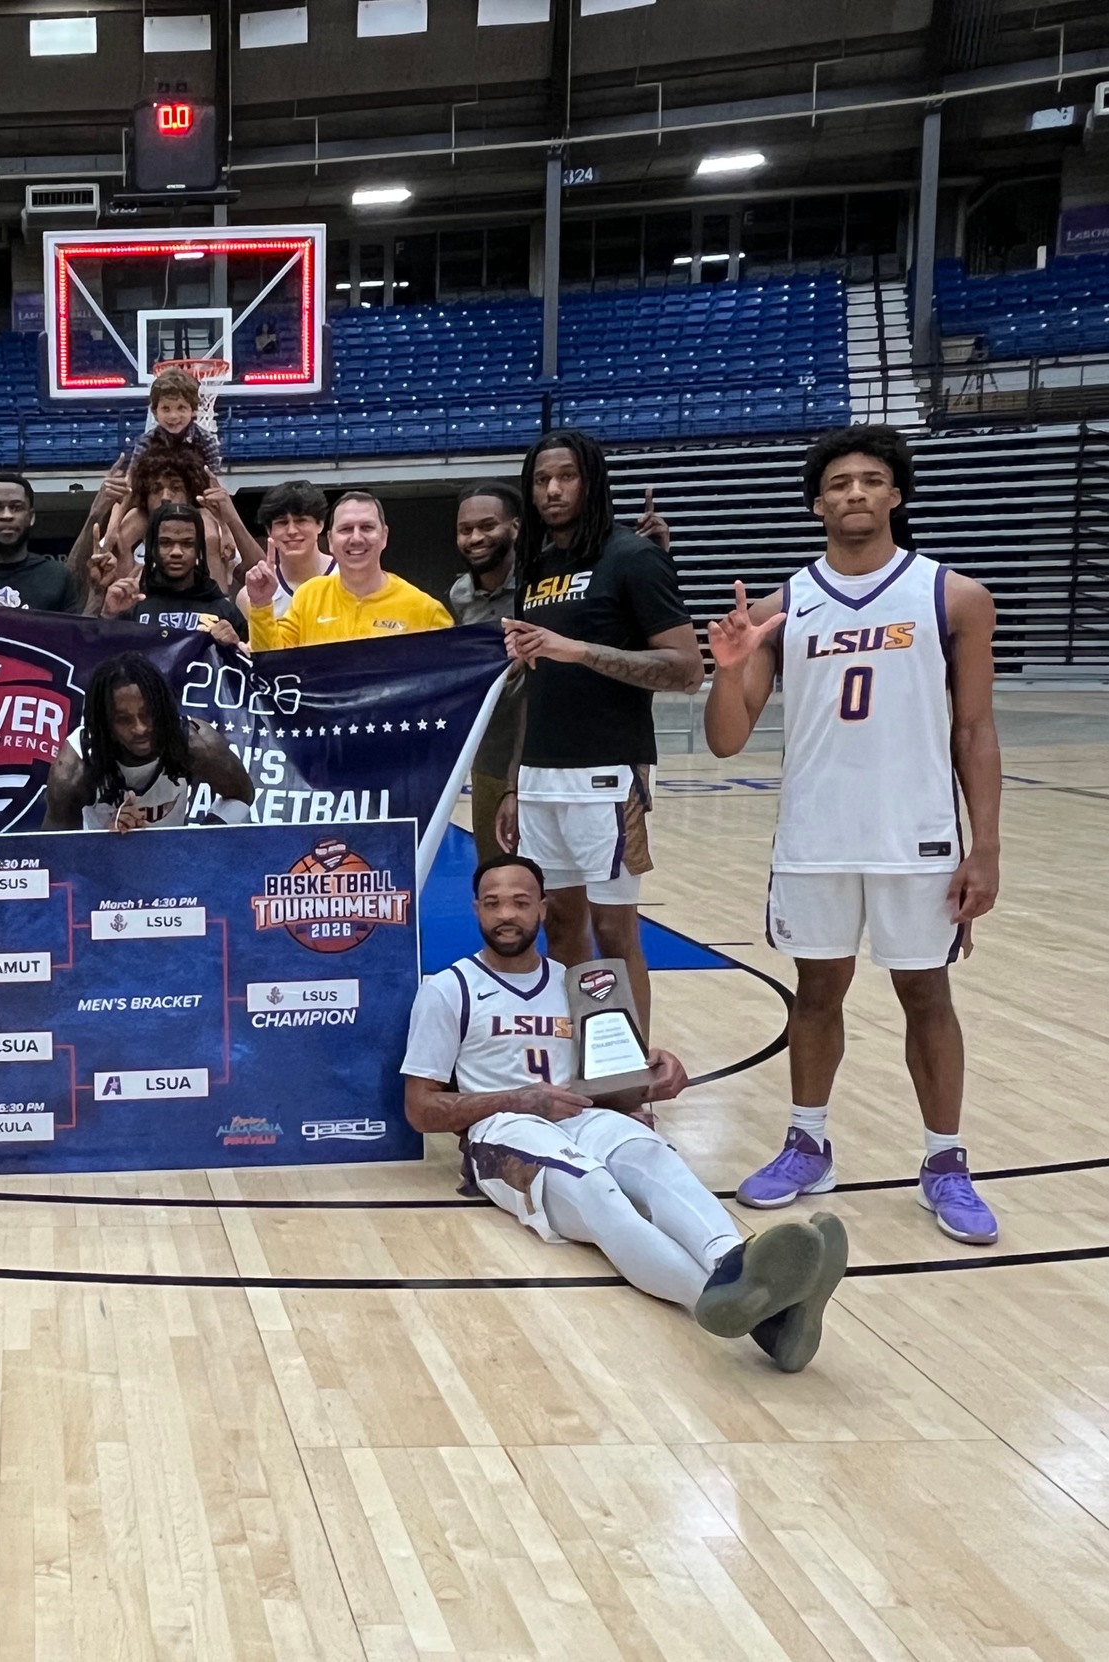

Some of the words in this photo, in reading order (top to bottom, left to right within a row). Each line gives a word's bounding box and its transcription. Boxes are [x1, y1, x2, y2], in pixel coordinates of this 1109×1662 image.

[159, 105, 190, 129] 0.0
[524, 570, 593, 604] LSUS
[806, 621, 916, 659] LSUS
[839, 666, 874, 721] 0
[21, 858, 40, 868] PM
[265, 870, 397, 897] BASKETBALL
[99, 899, 134, 910] March
[179, 896, 198, 906] PM
[254, 894, 408, 926] TOURNAMENT
[146, 916, 183, 928] LSUS
[311, 923, 352, 938] 2026
[77, 998, 127, 1012] MEN'S
[130, 994, 202, 1010] BRACKET
[303, 989, 338, 1002] LSUS
[251, 1009, 357, 1028] CHAMPION
[491, 1015, 573, 1040] LSUS
[526, 1048, 552, 1085] 4
[145, 1077, 192, 1091] LSUA
[26, 1102, 45, 1112] PM
